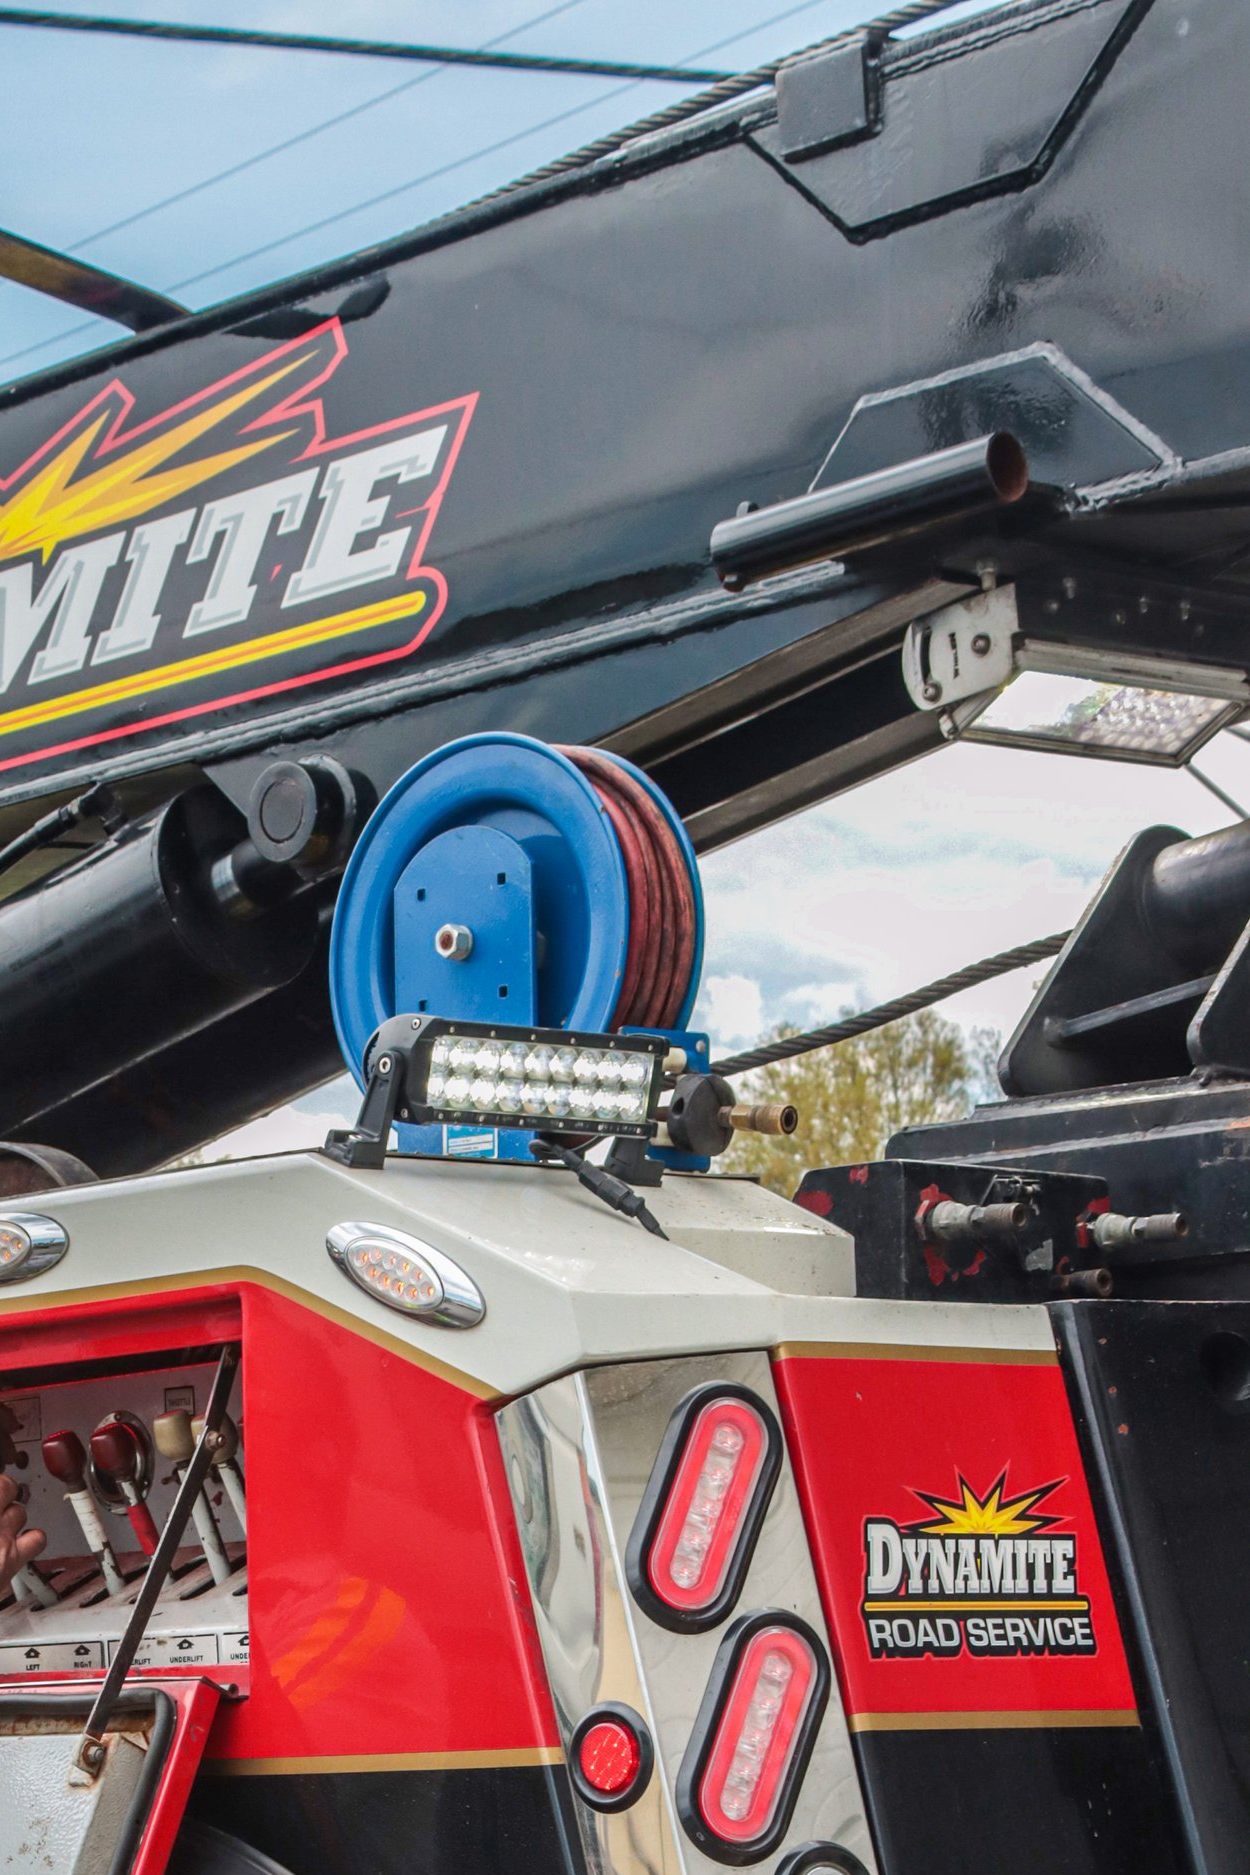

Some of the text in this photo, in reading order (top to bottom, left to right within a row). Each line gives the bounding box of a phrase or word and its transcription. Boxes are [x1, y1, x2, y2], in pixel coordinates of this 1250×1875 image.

[867, 1523, 1075, 1595] DYNAMITE
[869, 1617, 1094, 1648] ROAD SERVICE
[169, 1655, 204, 1664] UNDERLIFT
